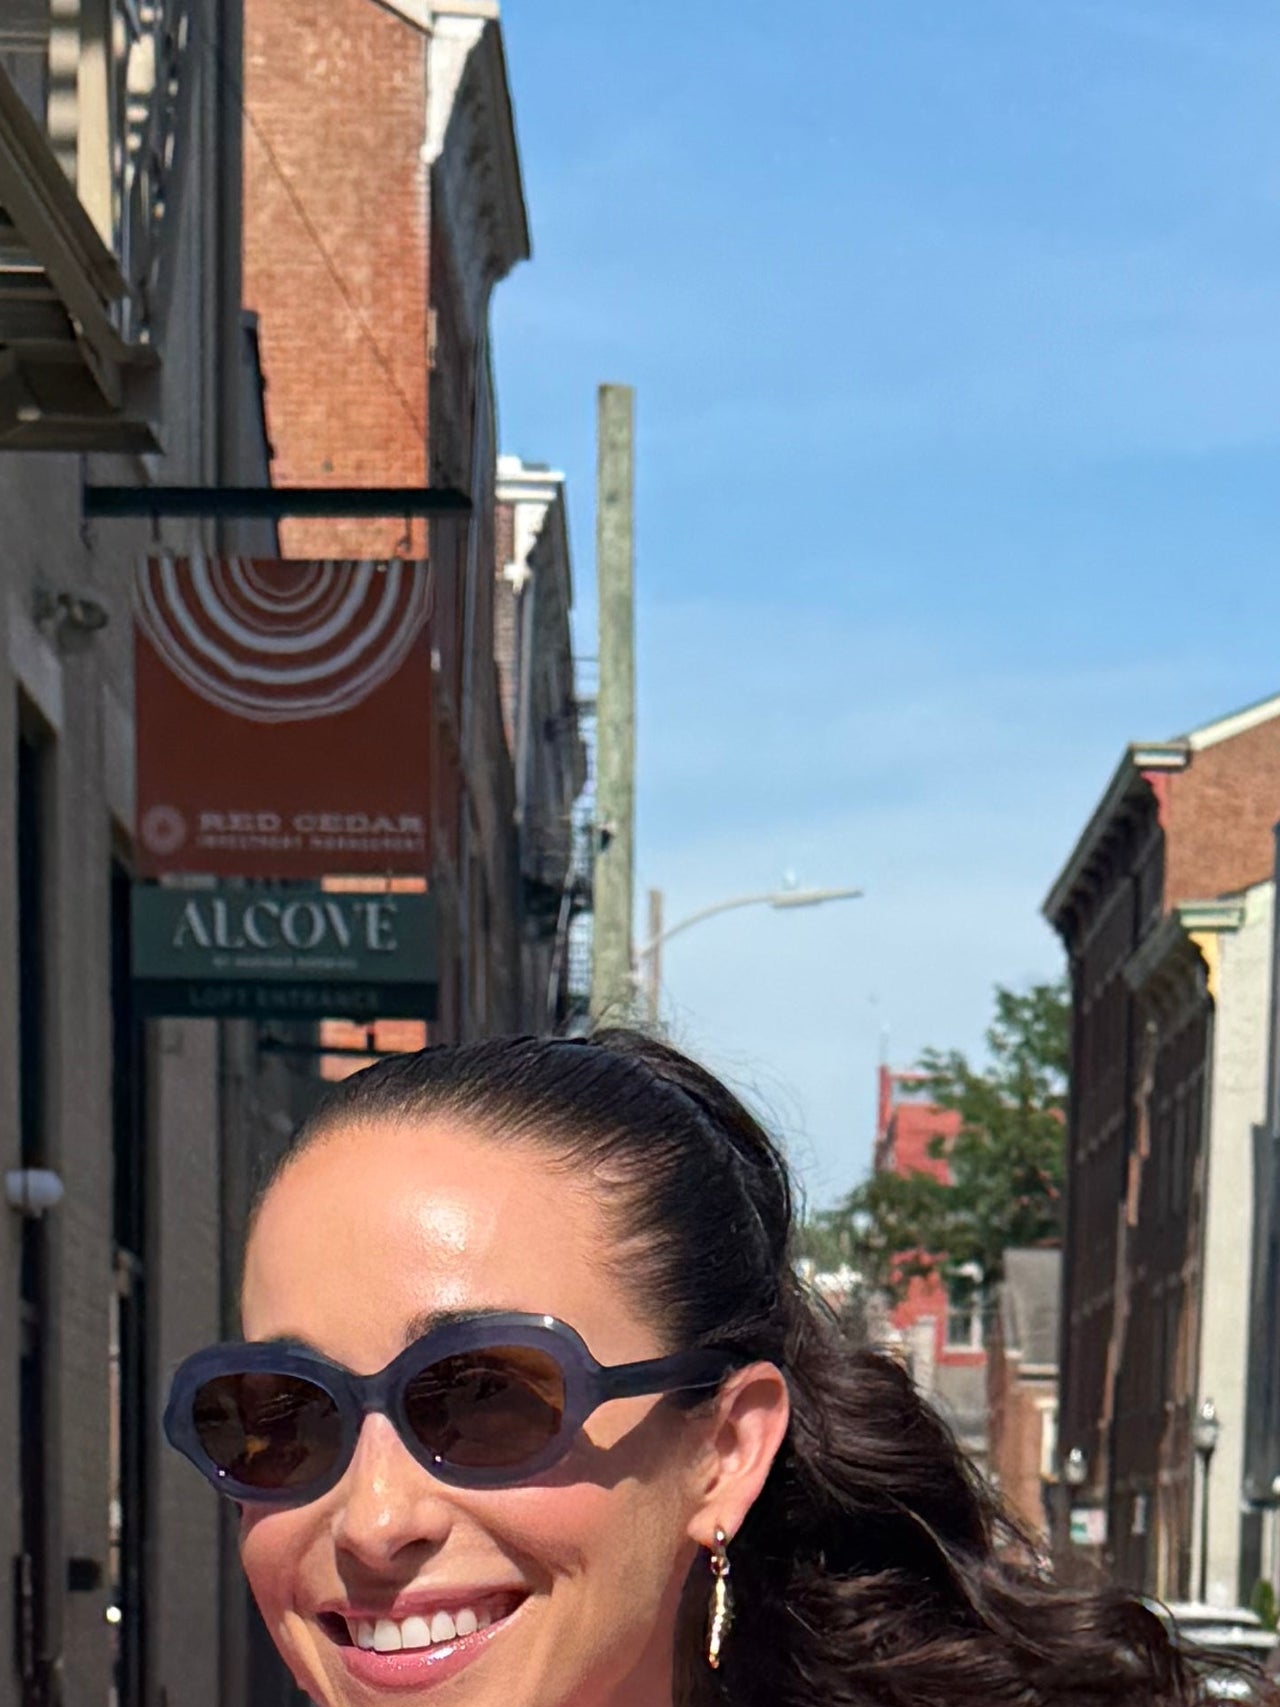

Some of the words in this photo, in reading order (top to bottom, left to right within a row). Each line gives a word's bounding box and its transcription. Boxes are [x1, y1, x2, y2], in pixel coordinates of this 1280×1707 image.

[200, 811, 282, 832] RED
[293, 812, 423, 833] CEDAR
[173, 898, 399, 951] ALCOVE
[255, 987, 380, 1009] ENTRANCE
